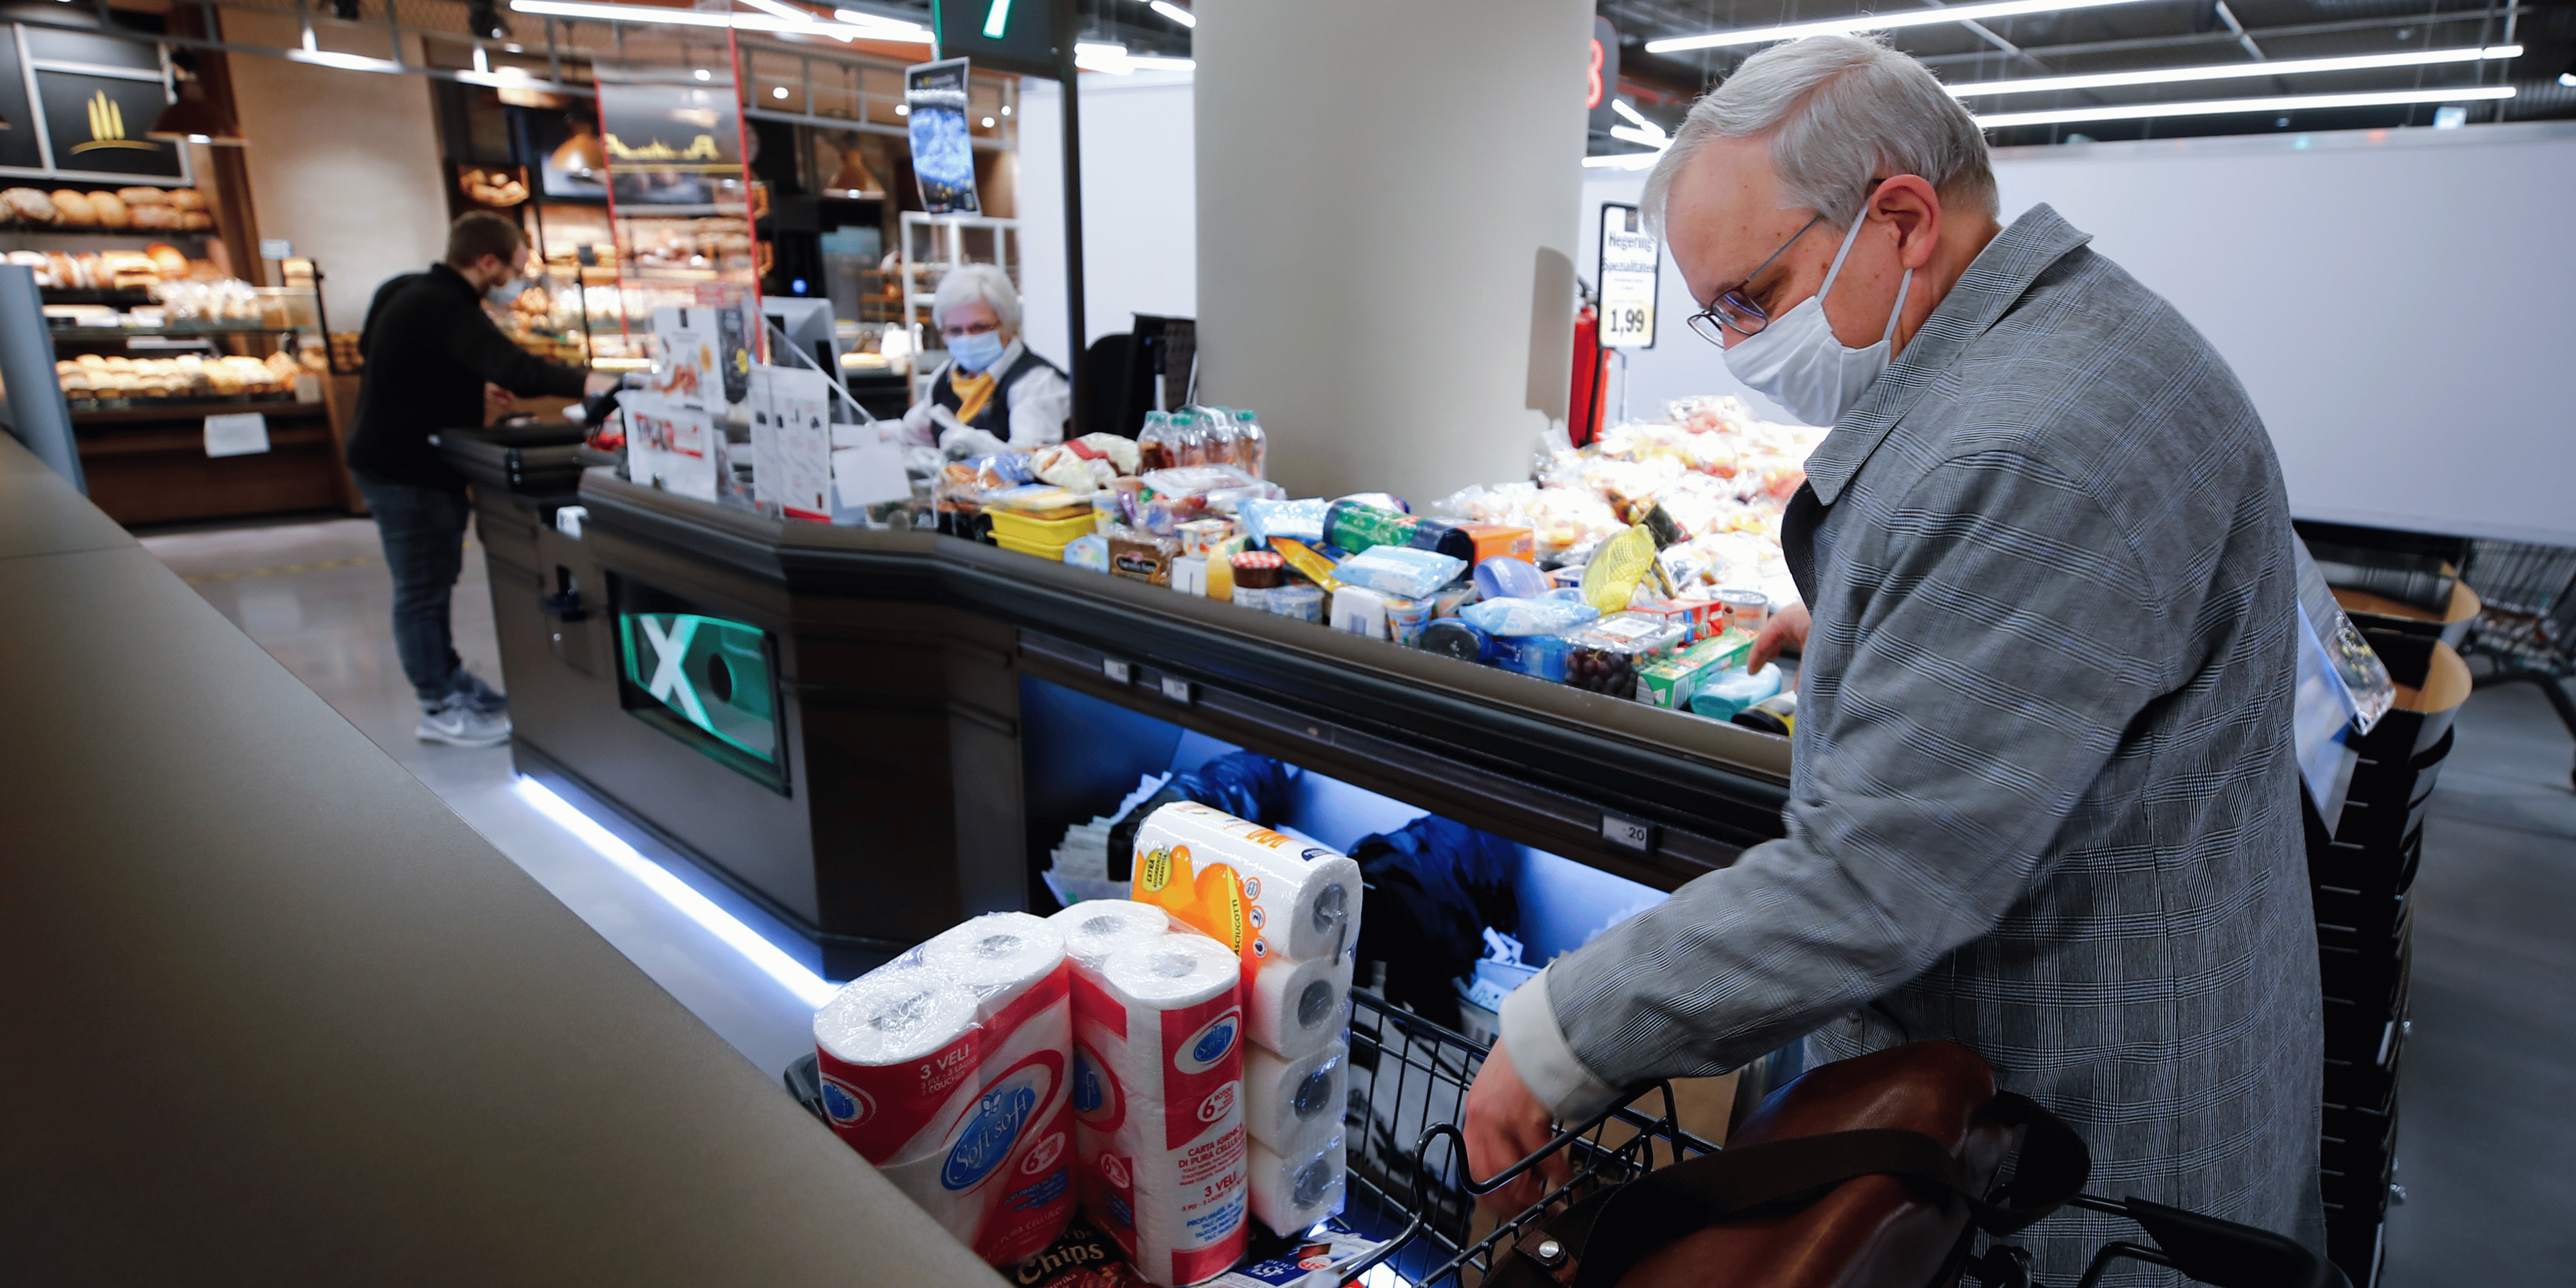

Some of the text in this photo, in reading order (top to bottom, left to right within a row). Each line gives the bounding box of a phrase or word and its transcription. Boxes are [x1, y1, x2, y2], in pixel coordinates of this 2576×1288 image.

[1611, 309, 1645, 337] 1,99
[1629, 826, 1645, 841] 20
[1146, 859, 1155, 883] EXTRA
[1158, 853, 1167, 886] GARANTITA
[920, 1044, 969, 1079] 3 VELI
[1203, 1098, 1215, 1119] 6
[954, 1086, 1027, 1181] Soft soft
[1179, 1159, 1188, 1168] DI
[1191, 1151, 1214, 1165] PURA
[1188, 1142, 1215, 1157] CARTA
[1026, 1152, 1039, 1172] 6
[1204, 1185, 1212, 1197] 3
[1216, 1171, 1236, 1191] VELI
[1017, 1244, 1104, 1285] Chips
[1044, 1273, 1077, 1288] aprika
